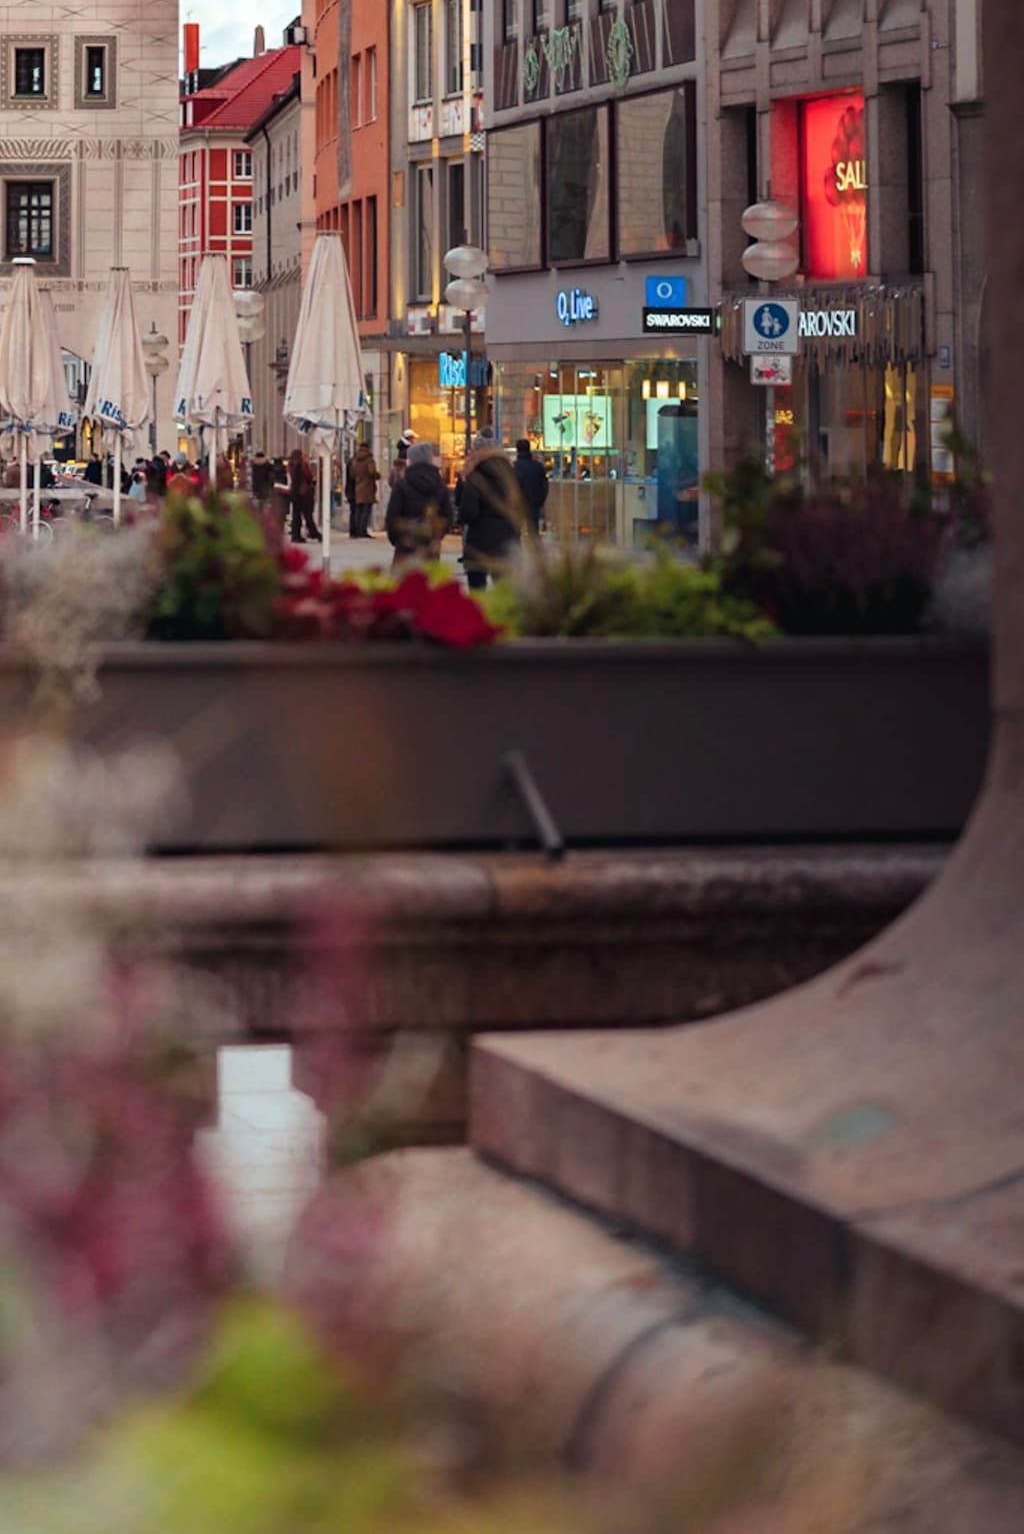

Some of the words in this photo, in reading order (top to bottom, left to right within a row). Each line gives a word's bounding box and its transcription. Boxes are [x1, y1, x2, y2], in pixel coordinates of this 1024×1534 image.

[571, 289, 593, 319] Live
[646, 314, 710, 327] SWAROVSKI
[798, 310, 856, 337] AROVSKI
[757, 341, 785, 350] ZONE
